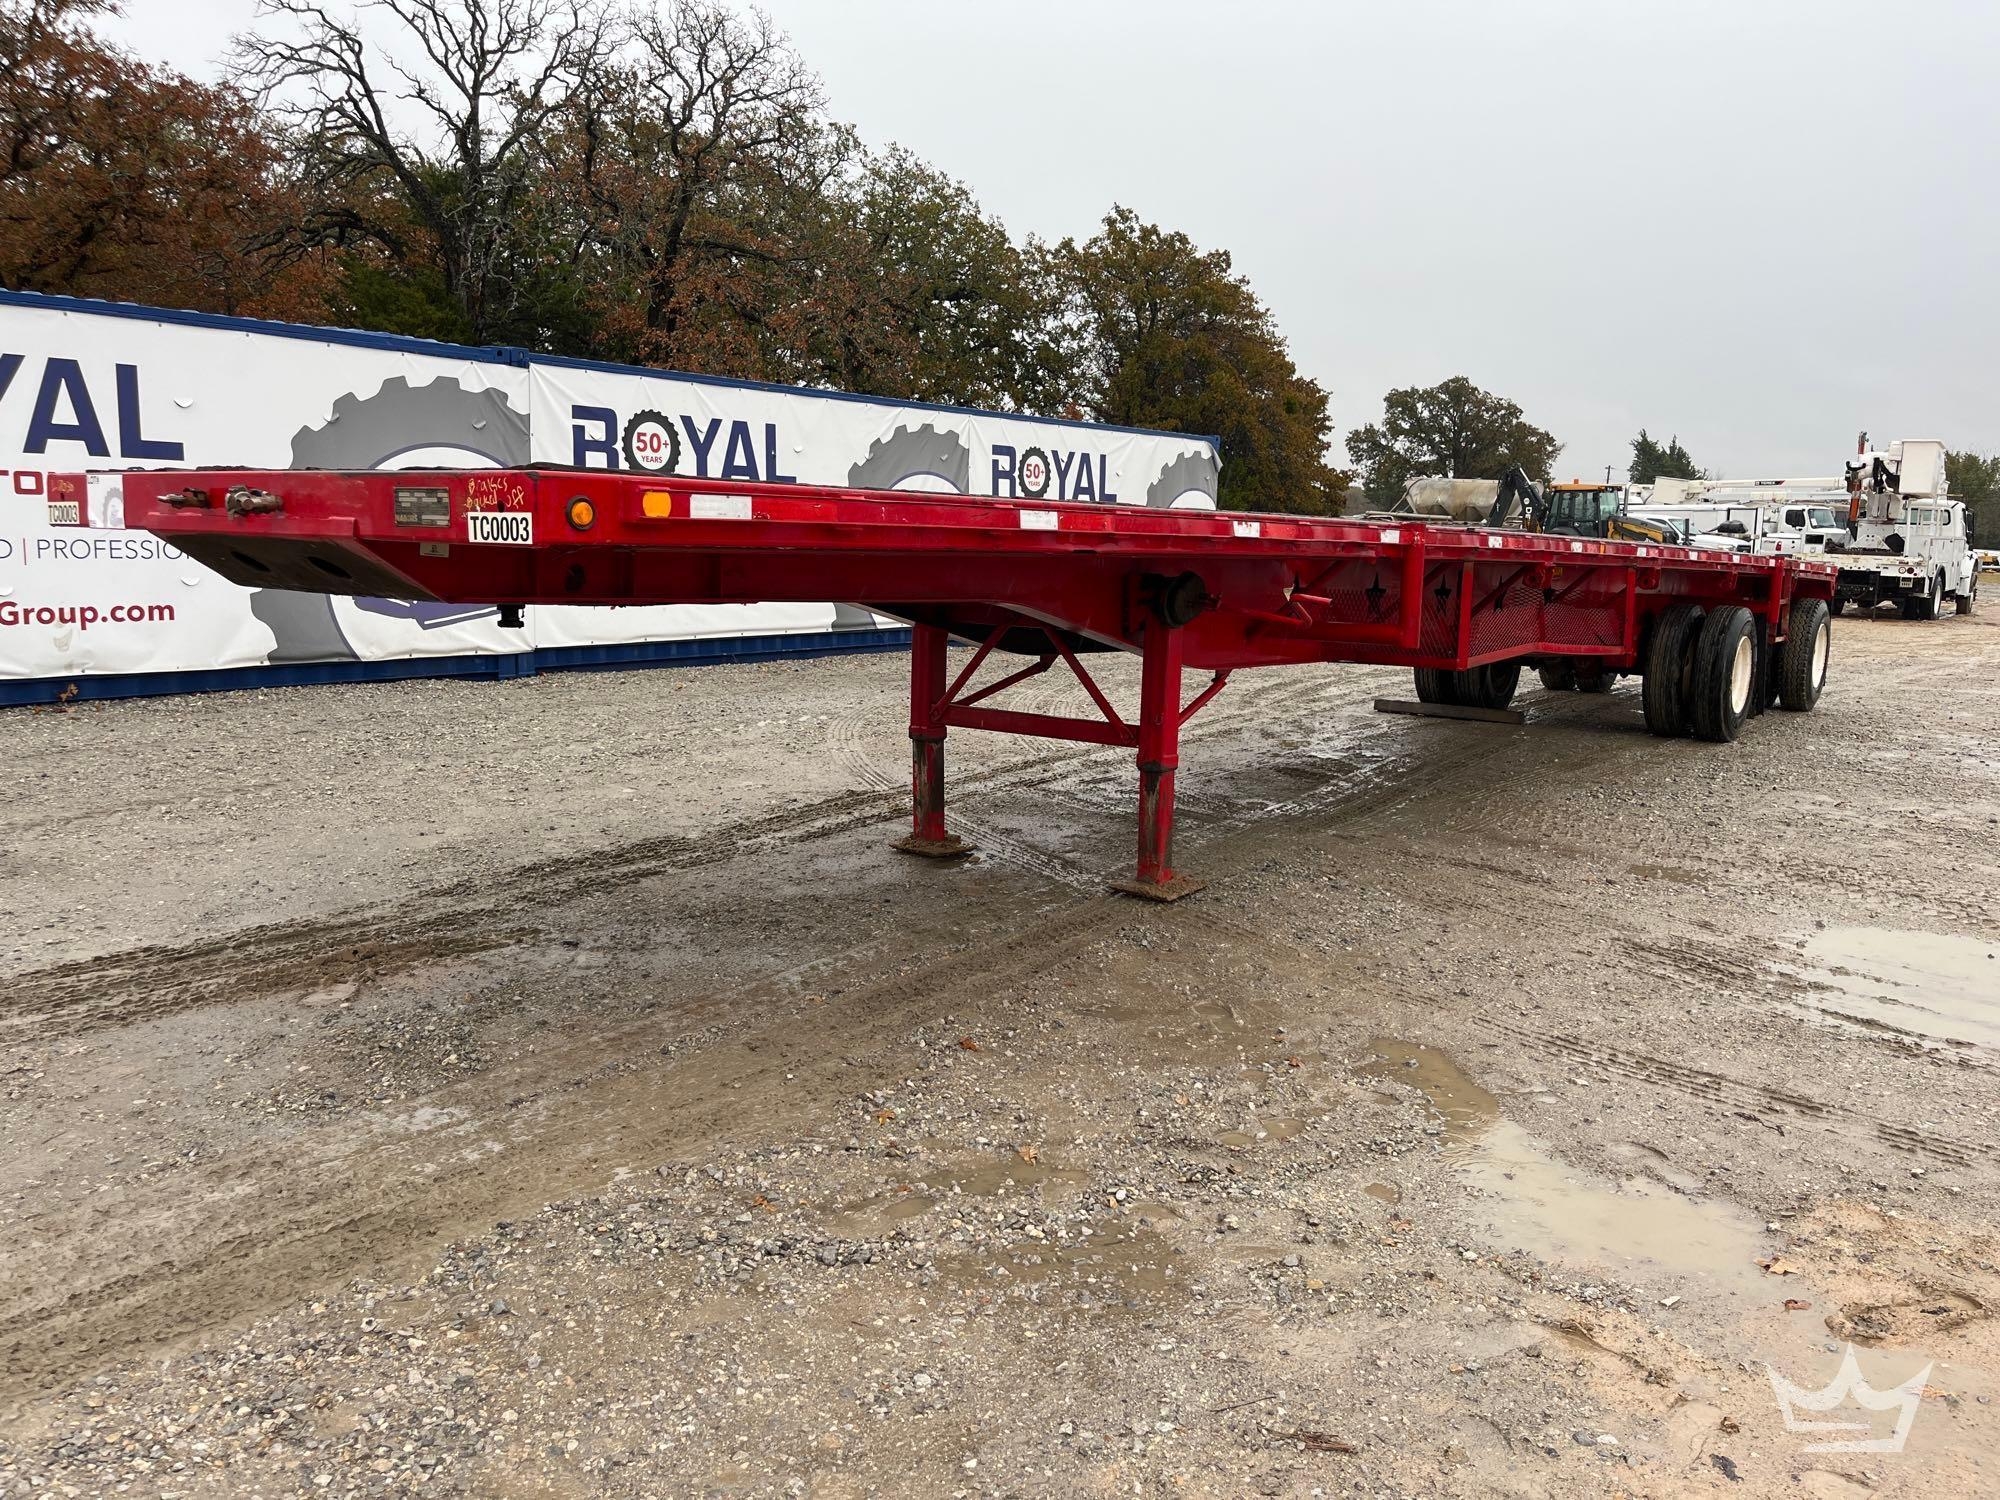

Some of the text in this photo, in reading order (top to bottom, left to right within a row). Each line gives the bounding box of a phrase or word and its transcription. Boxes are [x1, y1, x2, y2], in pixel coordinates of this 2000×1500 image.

[0, 354, 184, 461] AL
[572, 405, 796, 483] ROYAL
[635, 431, 669, 453] 50+
[641, 455, 663, 464] YEARS
[992, 444, 1117, 502] ROYAL
[1025, 463, 1045, 479] 50+
[48, 505, 78, 523] TC0003
[470, 515, 530, 542] TC0003
[0, 600, 176, 631] Group.com
